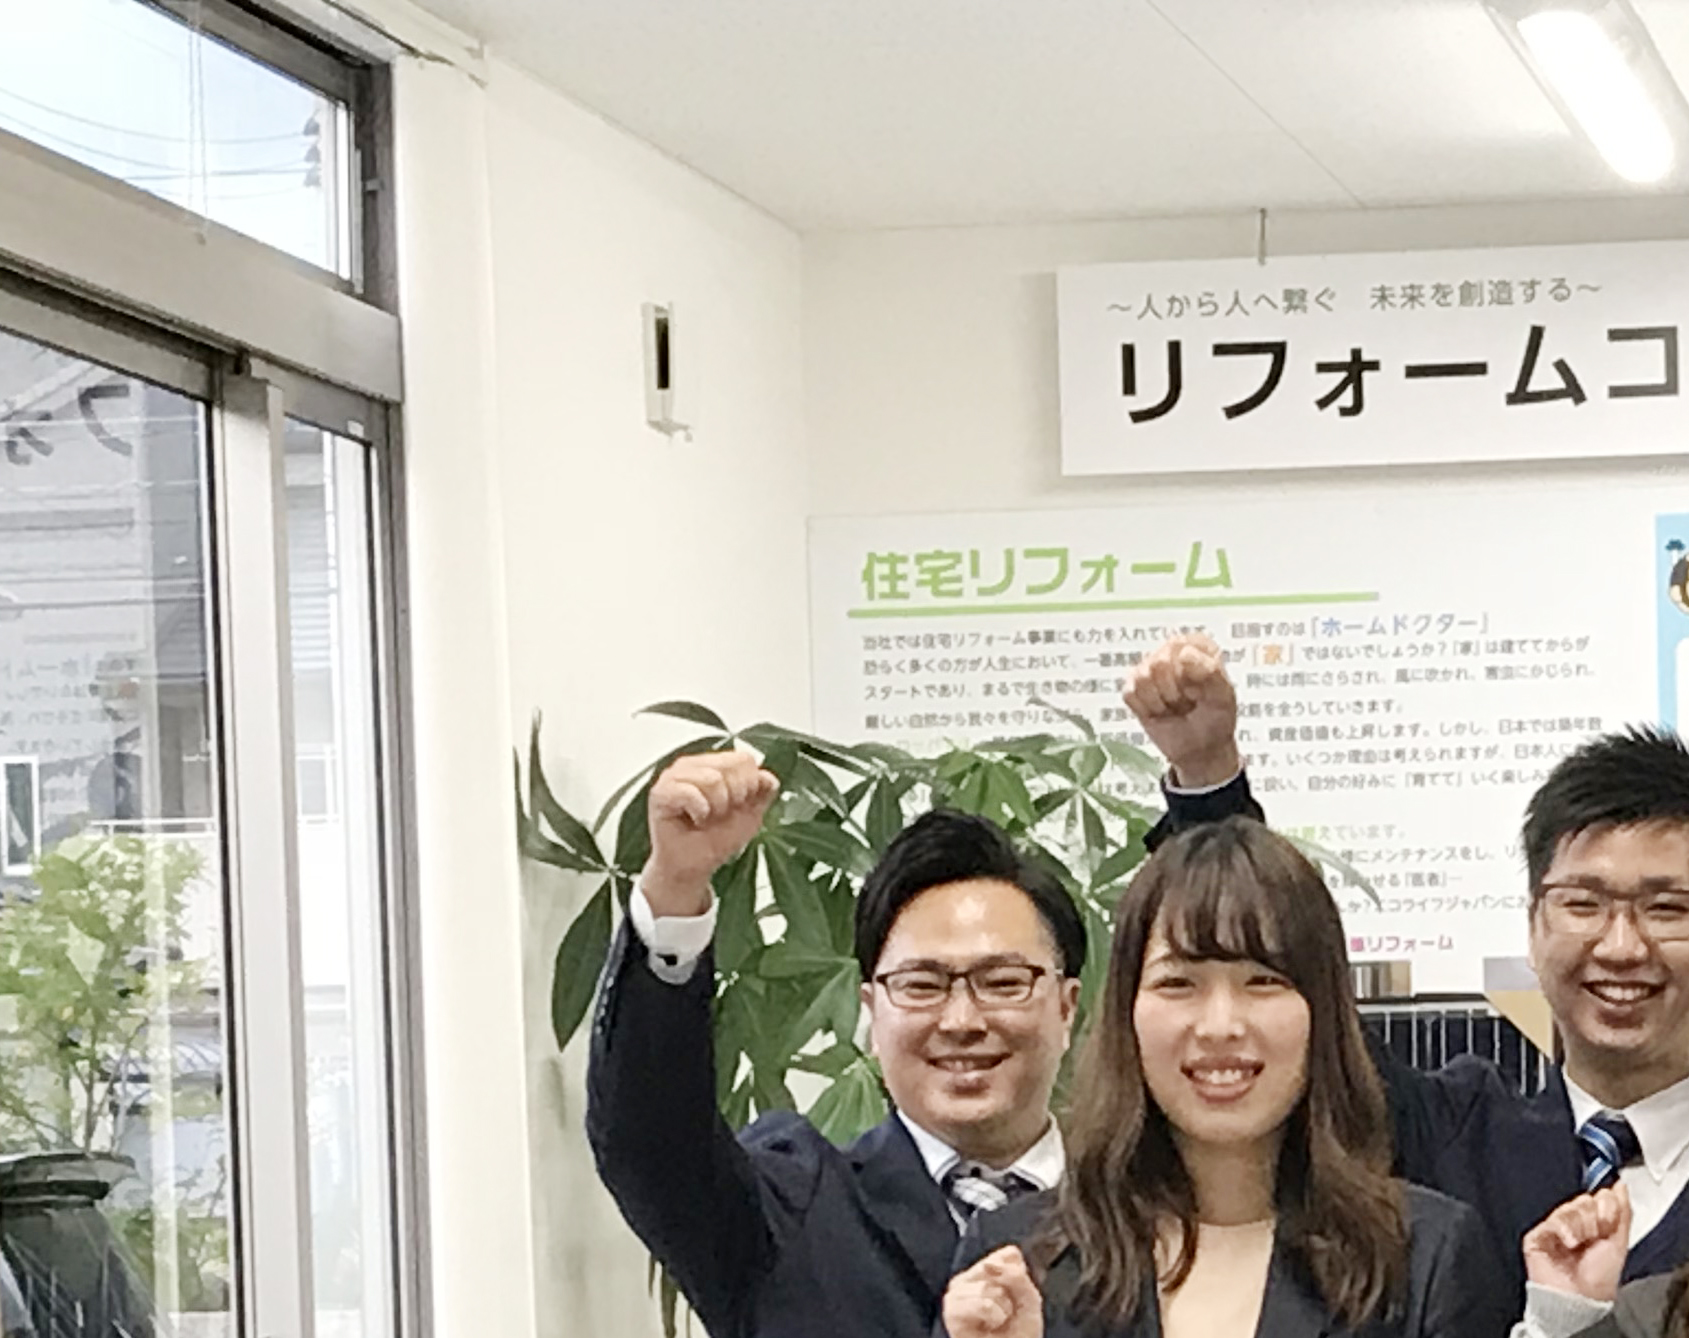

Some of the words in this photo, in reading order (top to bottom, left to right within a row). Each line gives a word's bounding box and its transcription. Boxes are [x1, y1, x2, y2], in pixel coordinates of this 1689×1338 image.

[862, 541, 1232, 601] 住宅リフォーム
